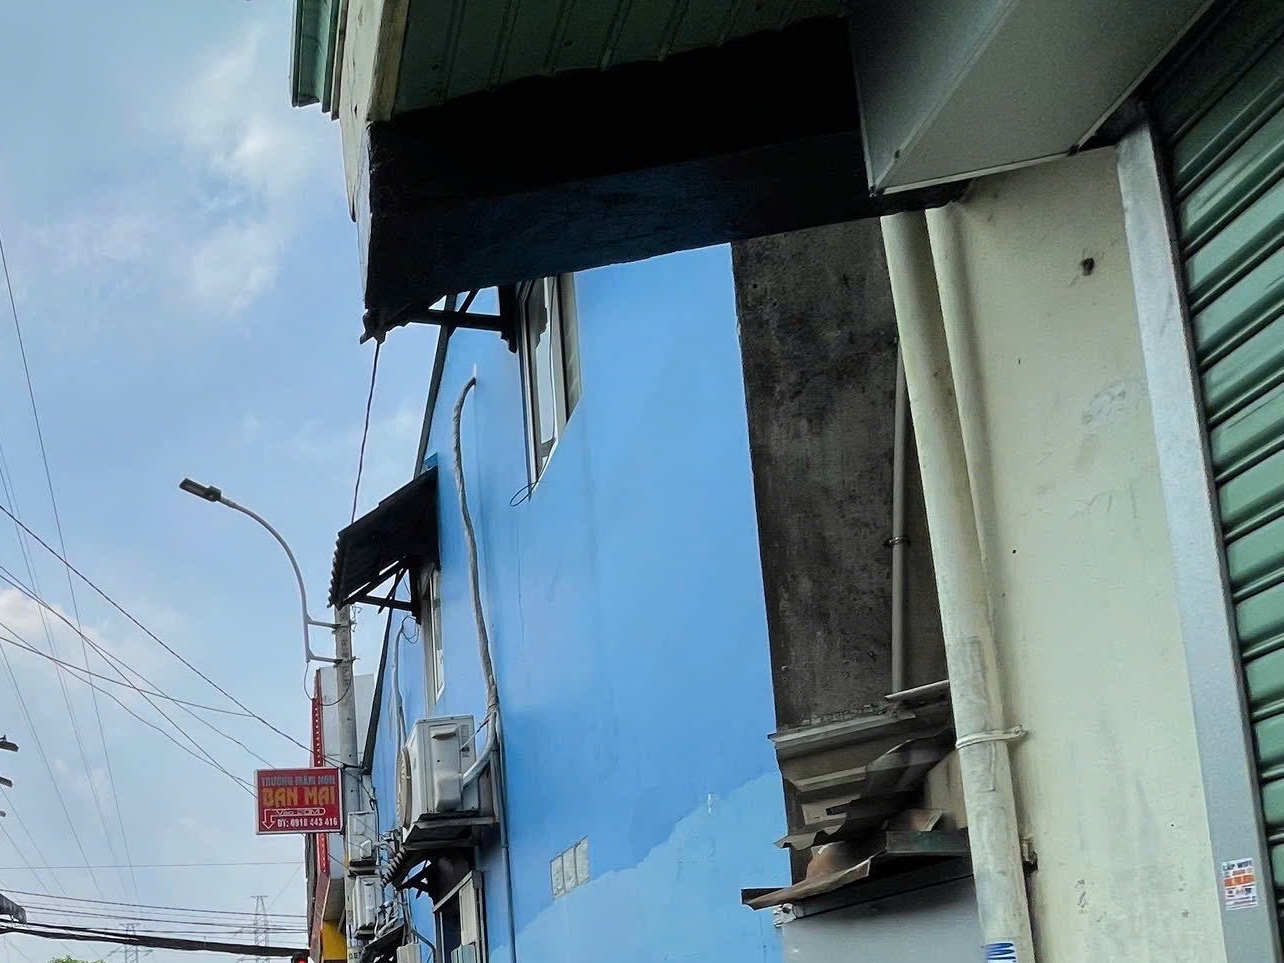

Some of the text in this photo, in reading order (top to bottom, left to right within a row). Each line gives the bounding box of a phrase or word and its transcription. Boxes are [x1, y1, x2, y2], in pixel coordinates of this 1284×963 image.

[262, 786, 336, 808] BAN MAI
[324, 817, 338, 826] 416
